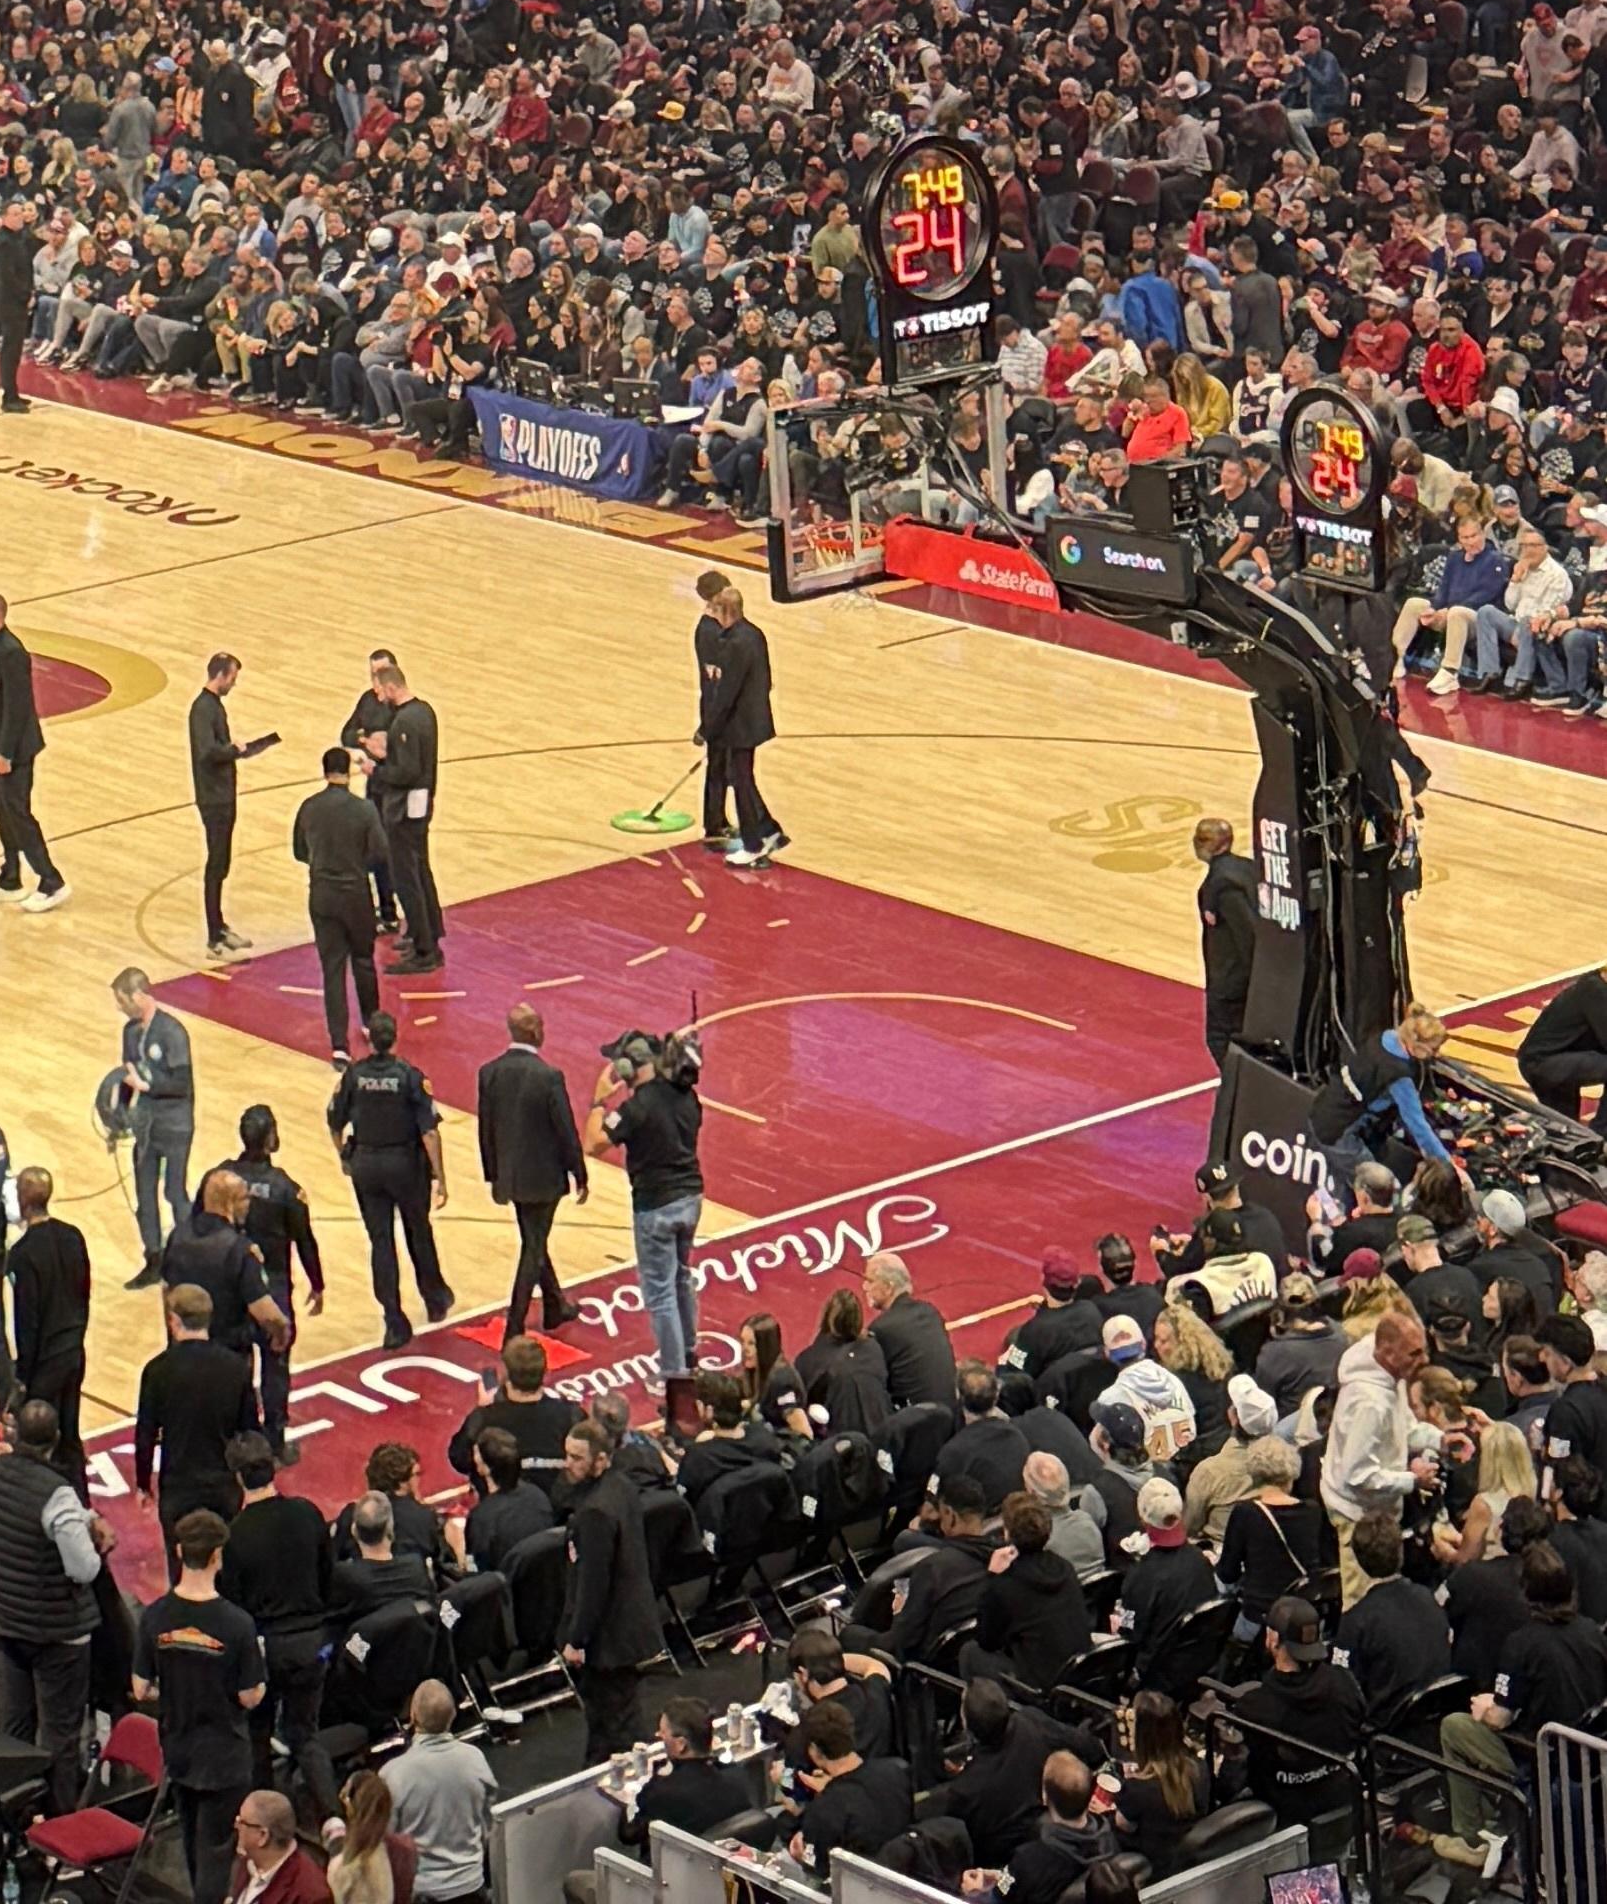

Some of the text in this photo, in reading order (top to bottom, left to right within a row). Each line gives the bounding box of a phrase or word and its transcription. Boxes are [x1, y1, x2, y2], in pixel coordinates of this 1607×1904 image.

[902, 164, 965, 210] 7:49
[893, 205, 964, 285] 24
[921, 301, 990, 334] TISSOT
[515, 418, 602, 482] PLAYOFFS
[1316, 420, 1365, 463] 7:49
[1310, 450, 1358, 499] 24
[1316, 518, 1374, 546] TISSOT
[1103, 545, 1146, 571] Search
[1259, 817, 1288, 854] GET
[1261, 850, 1292, 889] THE
[1271, 887, 1301, 932] App
[1240, 1130, 1335, 1191] coin
